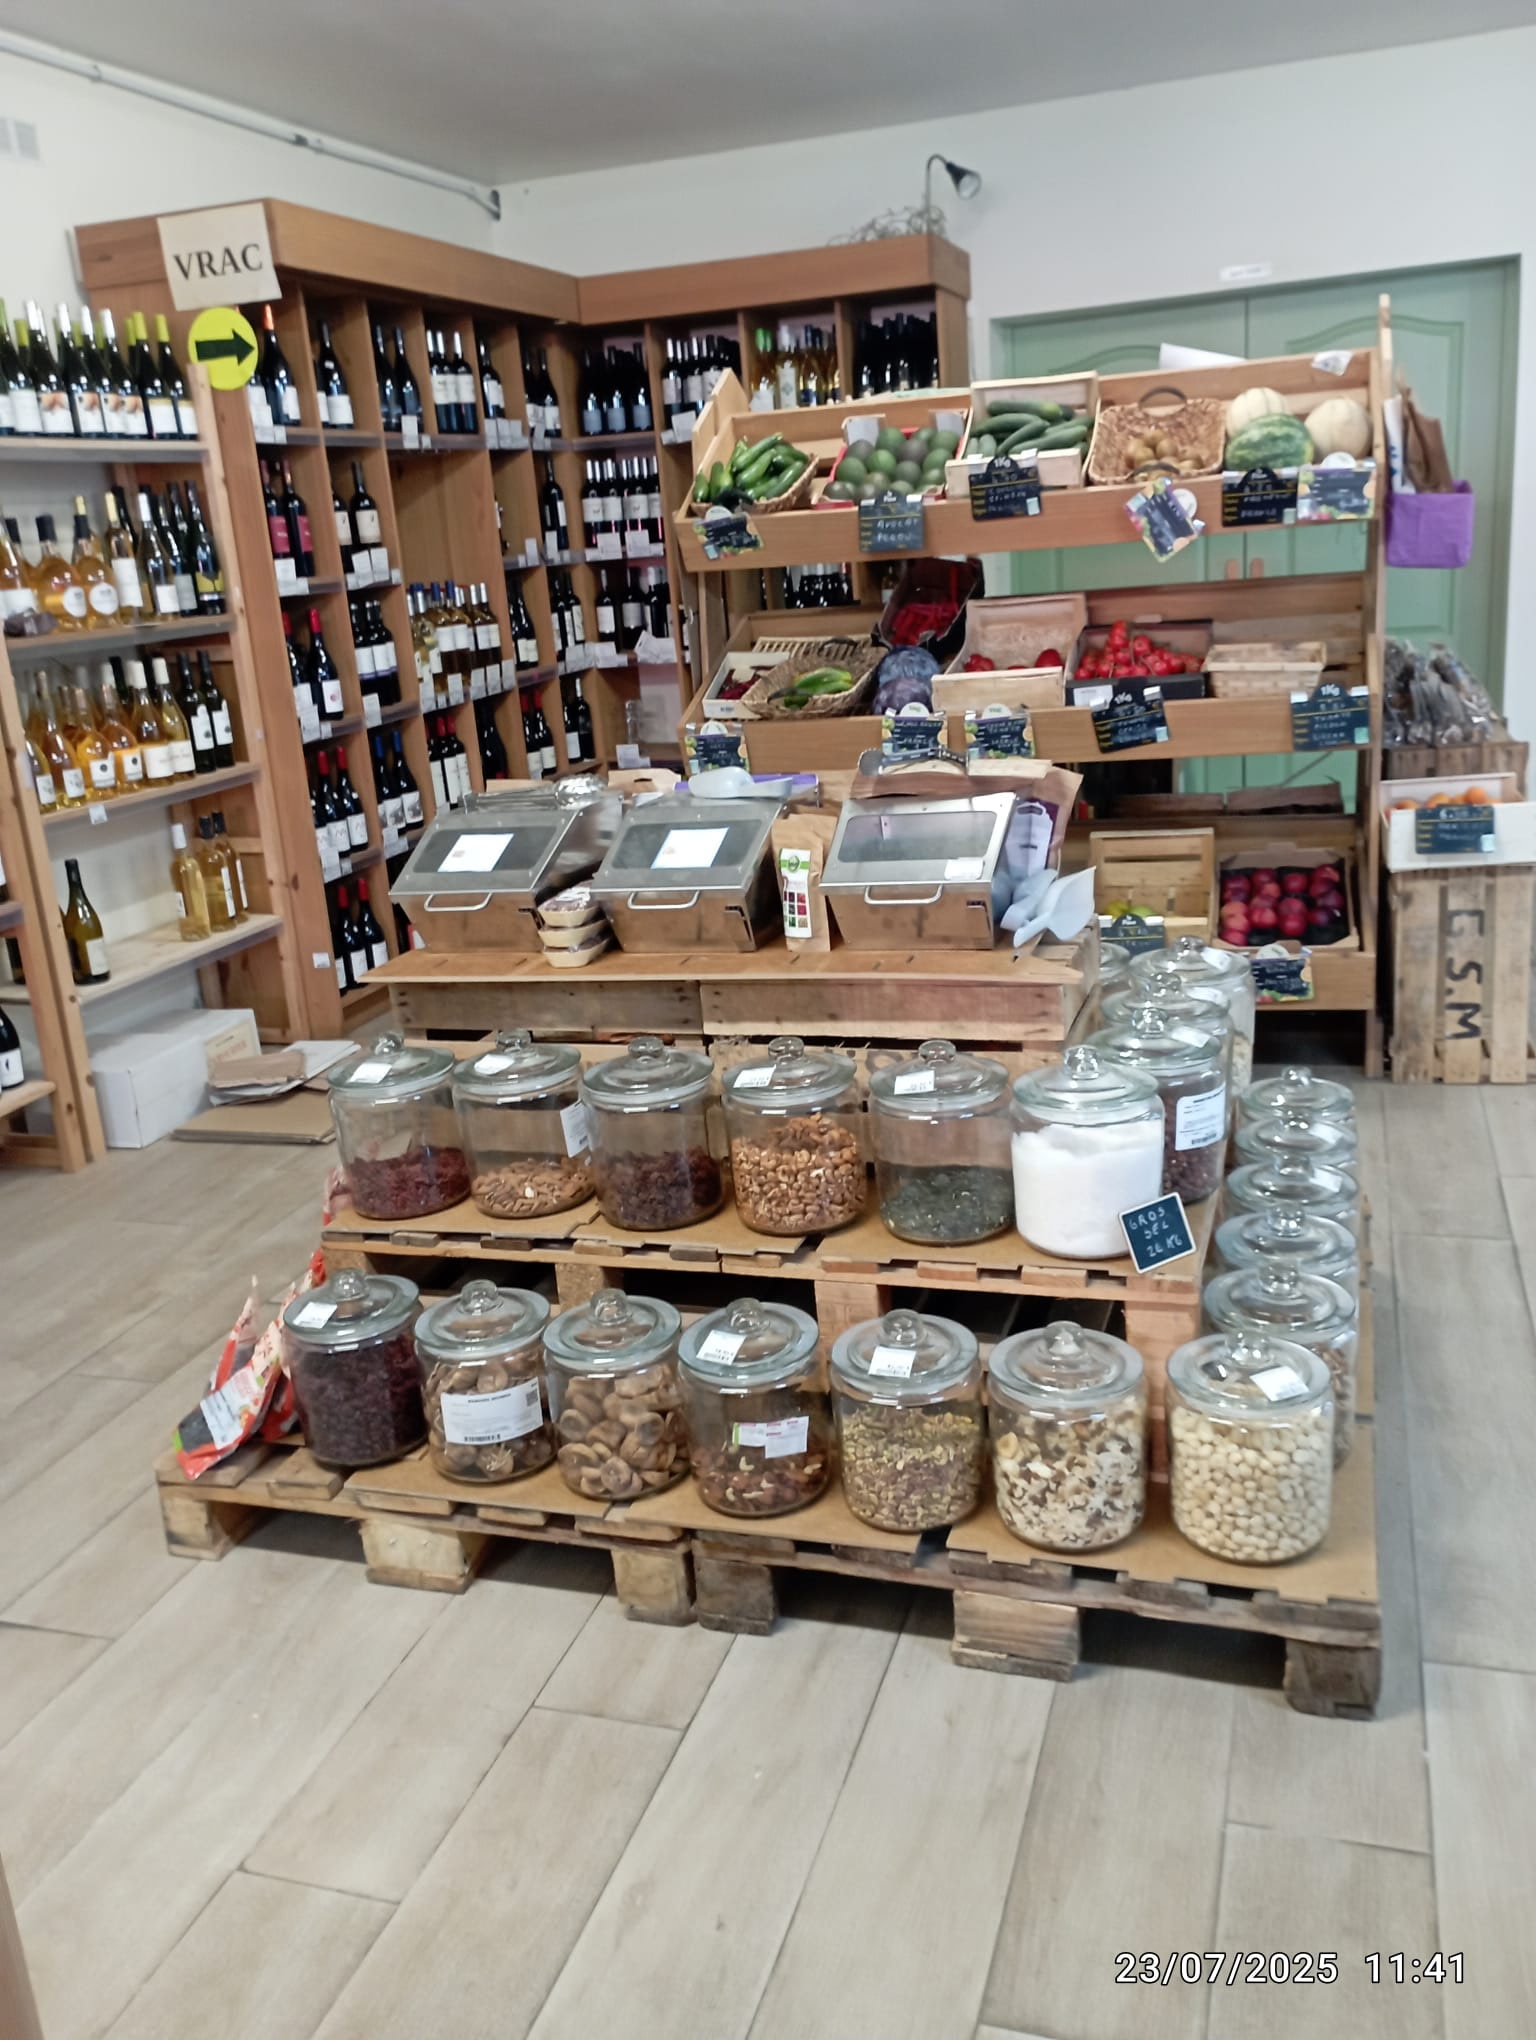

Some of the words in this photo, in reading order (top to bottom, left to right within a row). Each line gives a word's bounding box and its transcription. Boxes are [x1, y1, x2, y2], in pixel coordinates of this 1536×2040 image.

[172, 243, 264, 281] VRAC
[877, 517, 919, 529] AVOCAT
[1129, 1206, 1165, 1230] GROS
[1144, 1220, 1169, 1240] SEL
